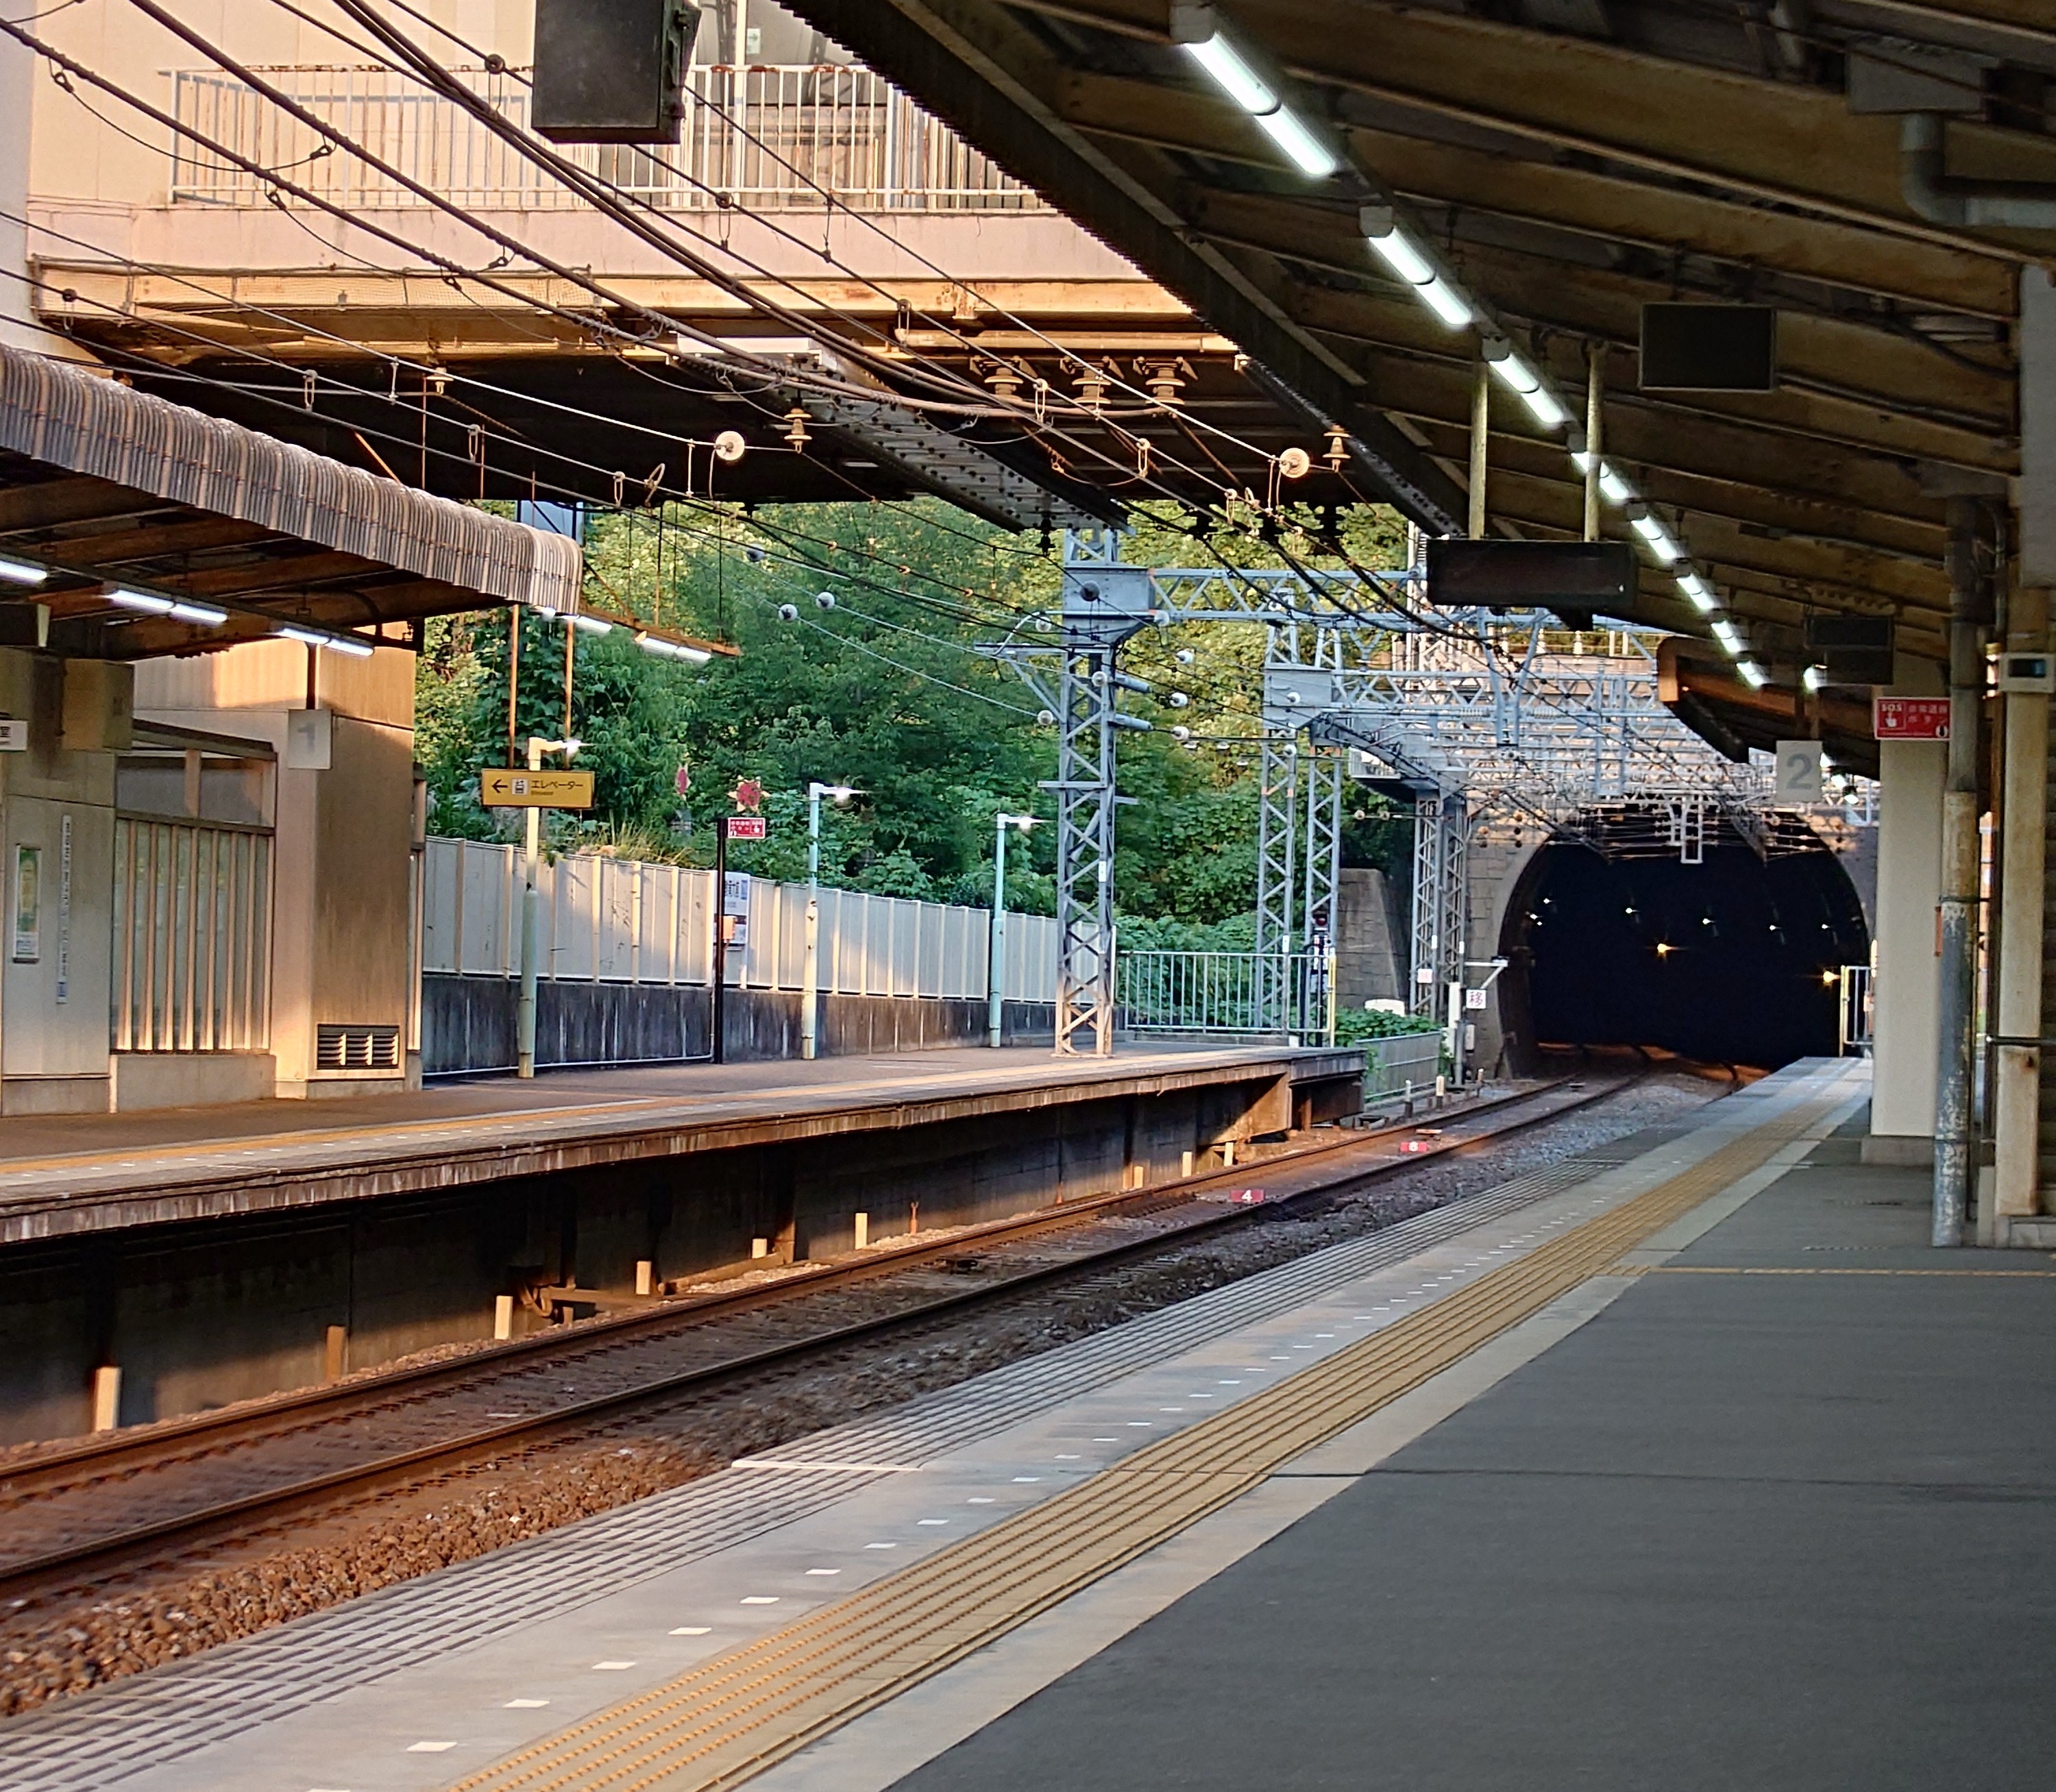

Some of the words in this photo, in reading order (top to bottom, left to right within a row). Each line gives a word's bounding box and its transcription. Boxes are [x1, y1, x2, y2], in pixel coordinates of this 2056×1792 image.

[297, 722, 315, 752] 1
[1787, 753, 1811, 789] 2
[531, 780, 583, 789] エレベーター
[1469, 991, 1483, 1007] 移
[1409, 1141, 1419, 1152] 6
[1241, 1190, 1253, 1204] 4
